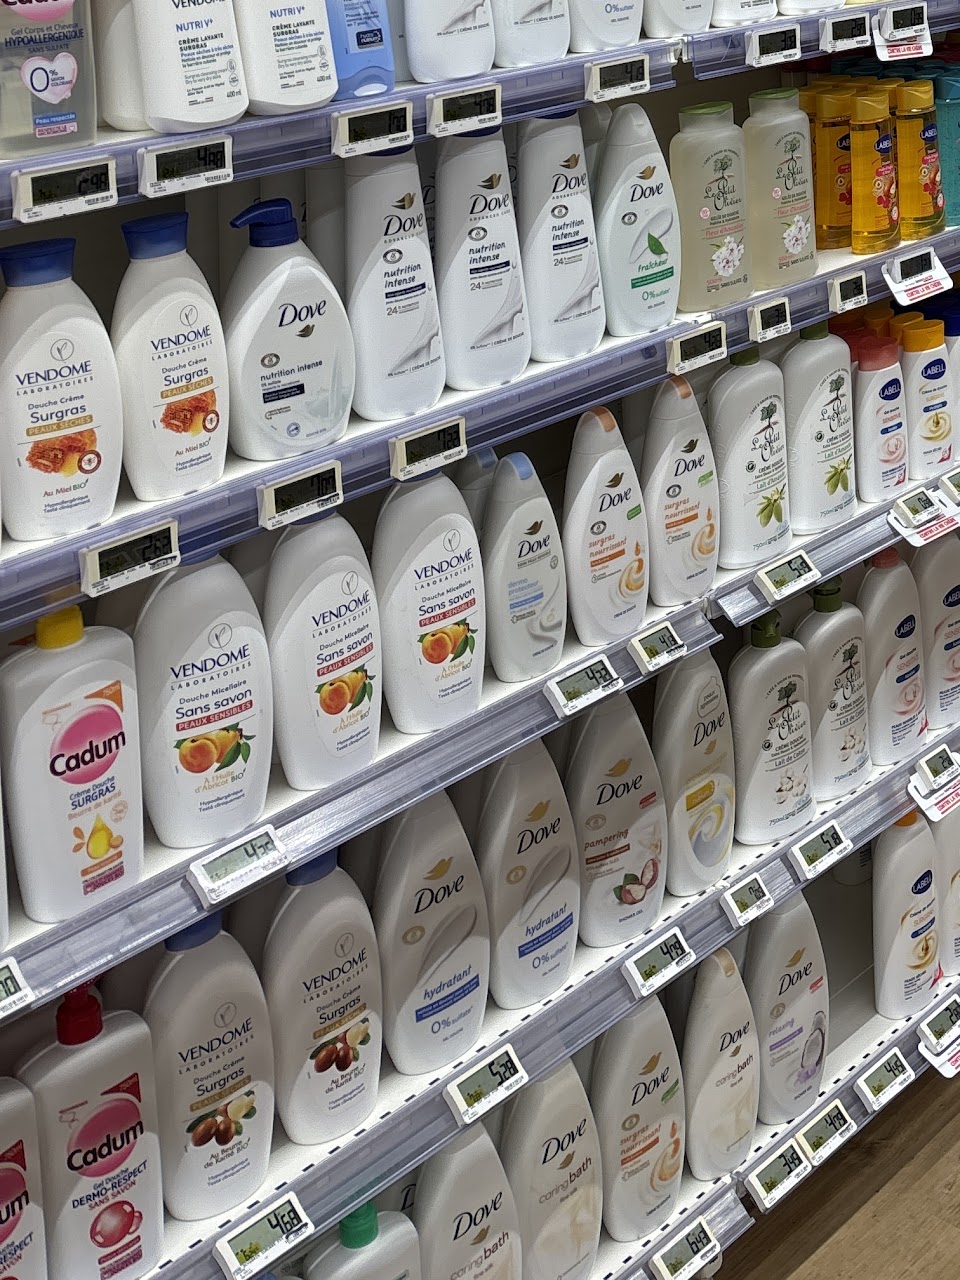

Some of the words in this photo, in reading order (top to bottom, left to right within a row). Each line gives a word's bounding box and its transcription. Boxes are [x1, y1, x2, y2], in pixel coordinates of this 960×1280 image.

[272, 23, 291, 31] CRÈME
[292, 20, 315, 28] LAVANTE
[273, 28, 299, 36] SURGRAS
[28, 45, 46, 53] SANS
[47, 43, 69, 52] SULFATE
[179, 37, 199, 46] CRÈME
[201, 32, 224, 43] LAVANTE
[180, 42, 207, 52] SURGRAS
[552, 172, 586, 194] Dove
[630, 182, 663, 202] Dove
[469, 192, 509, 215] Dove
[384, 213, 423, 237] Dove
[552, 219, 584, 231] nutrition
[468, 241, 506, 255] nutrition
[470, 252, 500, 264] intense
[383, 263, 421, 278] nutrition
[385, 275, 416, 289] intense
[278, 300, 327, 327] Dove
[150, 325, 212, 351] VENDOME
[152, 340, 213, 361] LABORATOIRES
[15, 360, 92, 386] VENDOME
[163, 366, 209, 387] Surgras
[260, 366, 296, 382] nutrition
[297, 359, 323, 375] intense
[922, 365, 946, 378] LABELL
[17, 376, 93, 396] LABORATOIRES
[879, 384, 900, 398] LABELL
[28, 398, 58, 410] Douche
[60, 394, 84, 404] Crème
[30, 404, 86, 424] Surgras
[674, 454, 705, 477] Dove
[43, 489, 54, 497] Au
[55, 486, 72, 495] Miel
[72, 482, 86, 490] BIO
[599, 487, 631, 512] Dove
[665, 503, 700, 520] nourrissant
[517, 534, 550, 558] Dove
[414, 548, 473, 580] VENDOME
[312, 589, 370, 627] VENDOME
[418, 600, 446, 616] Sans
[448, 587, 475, 606] savon
[170, 644, 250, 679] VENDOME
[316, 649, 344, 666] Sans
[346, 632, 373, 653] savon
[171, 662, 251, 690] LABORATOIRES
[175, 704, 210, 720] Sans
[214, 689, 252, 710] savon
[179, 692, 209, 704] Douche
[211, 680, 247, 695] Micellaire
[178, 717, 208, 731] PEAUX
[209, 702, 251, 723] SENSIBLES
[693, 712, 725, 747] Dove
[50, 730, 126, 777] Cadum
[71, 783, 116, 810] SURGRAS
[597, 775, 642, 805] Dove
[517, 817, 560, 854] Dove
[584, 828, 629, 852] pampering
[414, 874, 464, 914] Dove
[912, 874, 932, 893] LABELL
[525, 902, 567, 937] hydratant
[302, 947, 367, 993] VENDOME
[424, 964, 472, 1000] hydratant
[779, 962, 812, 996] Dove
[319, 996, 361, 1025] Surgras
[178, 1018, 252, 1064] VENDOME
[720, 1020, 750, 1052] Dove
[196, 1067, 245, 1097] Surgras
[632, 1066, 669, 1106] Dove
[67, 1120, 145, 1172] Cadum
[542, 1118, 586, 1165] Dove
[72, 1160, 148, 1209] DERMO-RESPECT
[453, 1191, 502, 1241] Dove
